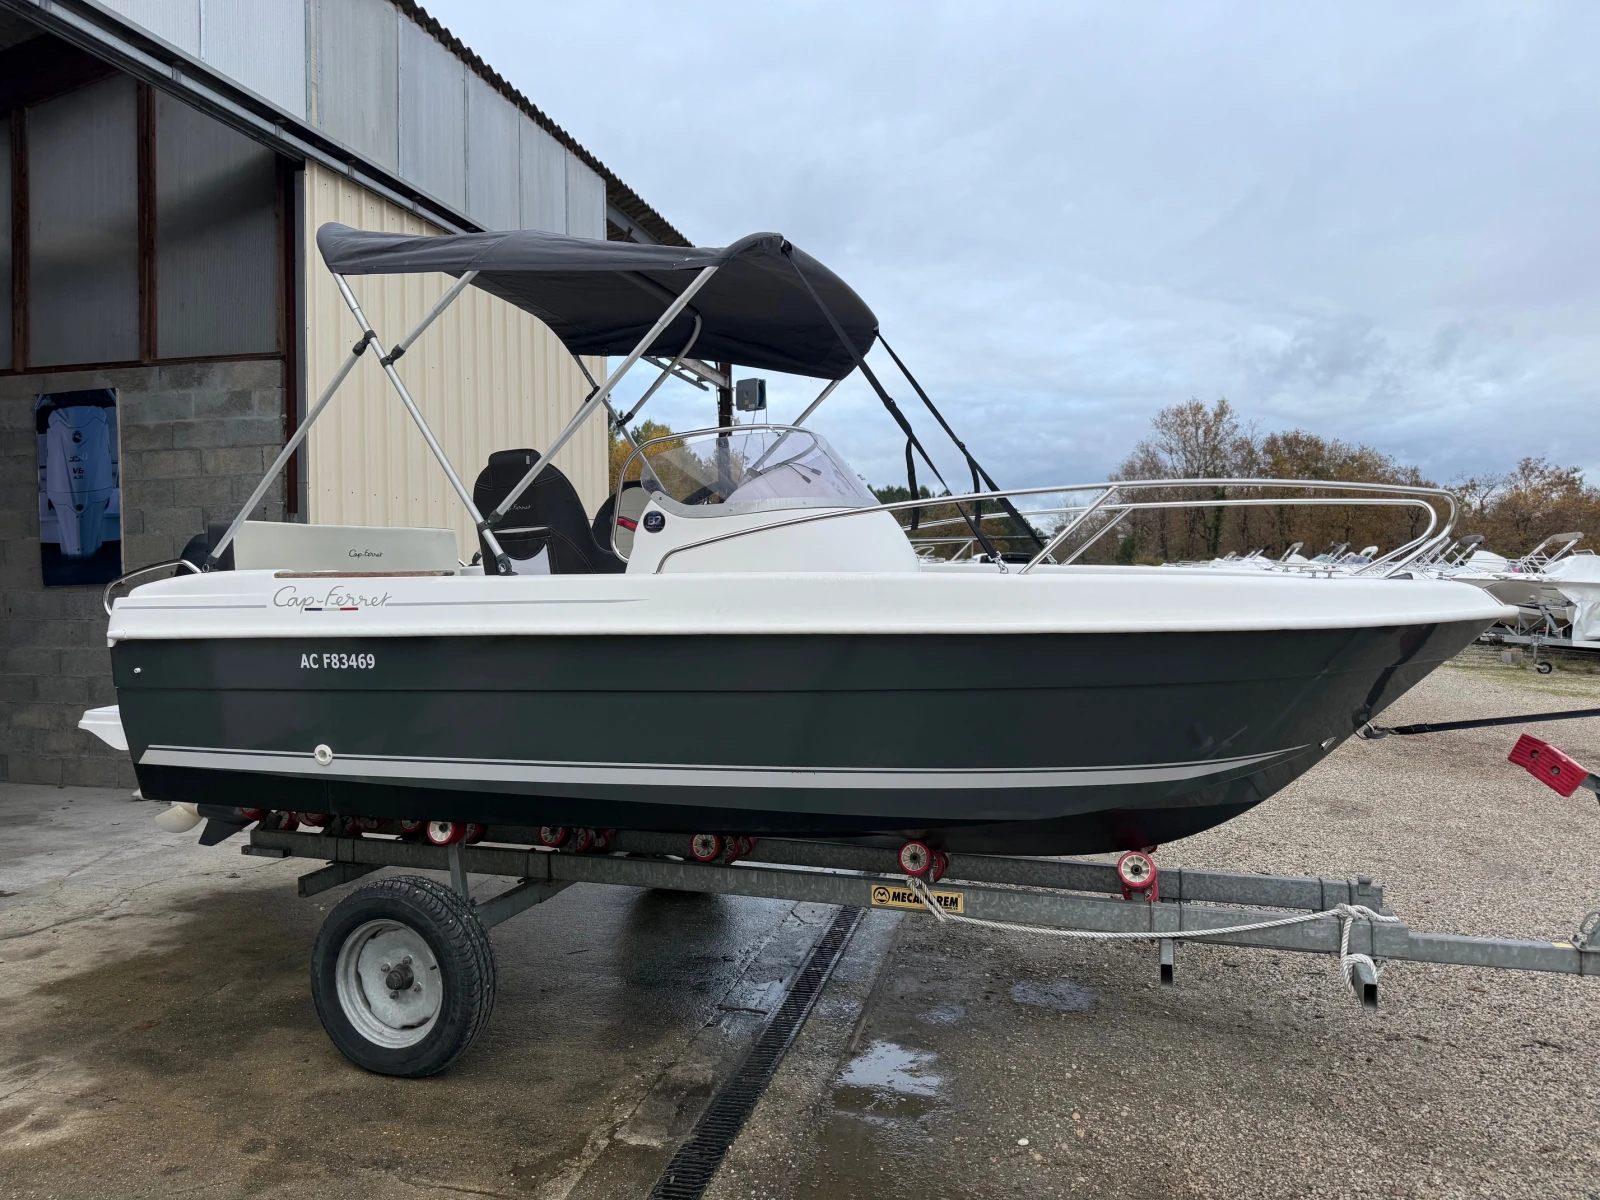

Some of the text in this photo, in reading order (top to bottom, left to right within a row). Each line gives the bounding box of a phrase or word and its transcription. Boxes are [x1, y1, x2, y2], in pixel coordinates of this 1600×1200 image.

[273, 585, 393, 614] Cap-Ferret
[300, 653, 376, 669] AC F83469
[891, 891, 959, 908] MECAREM
